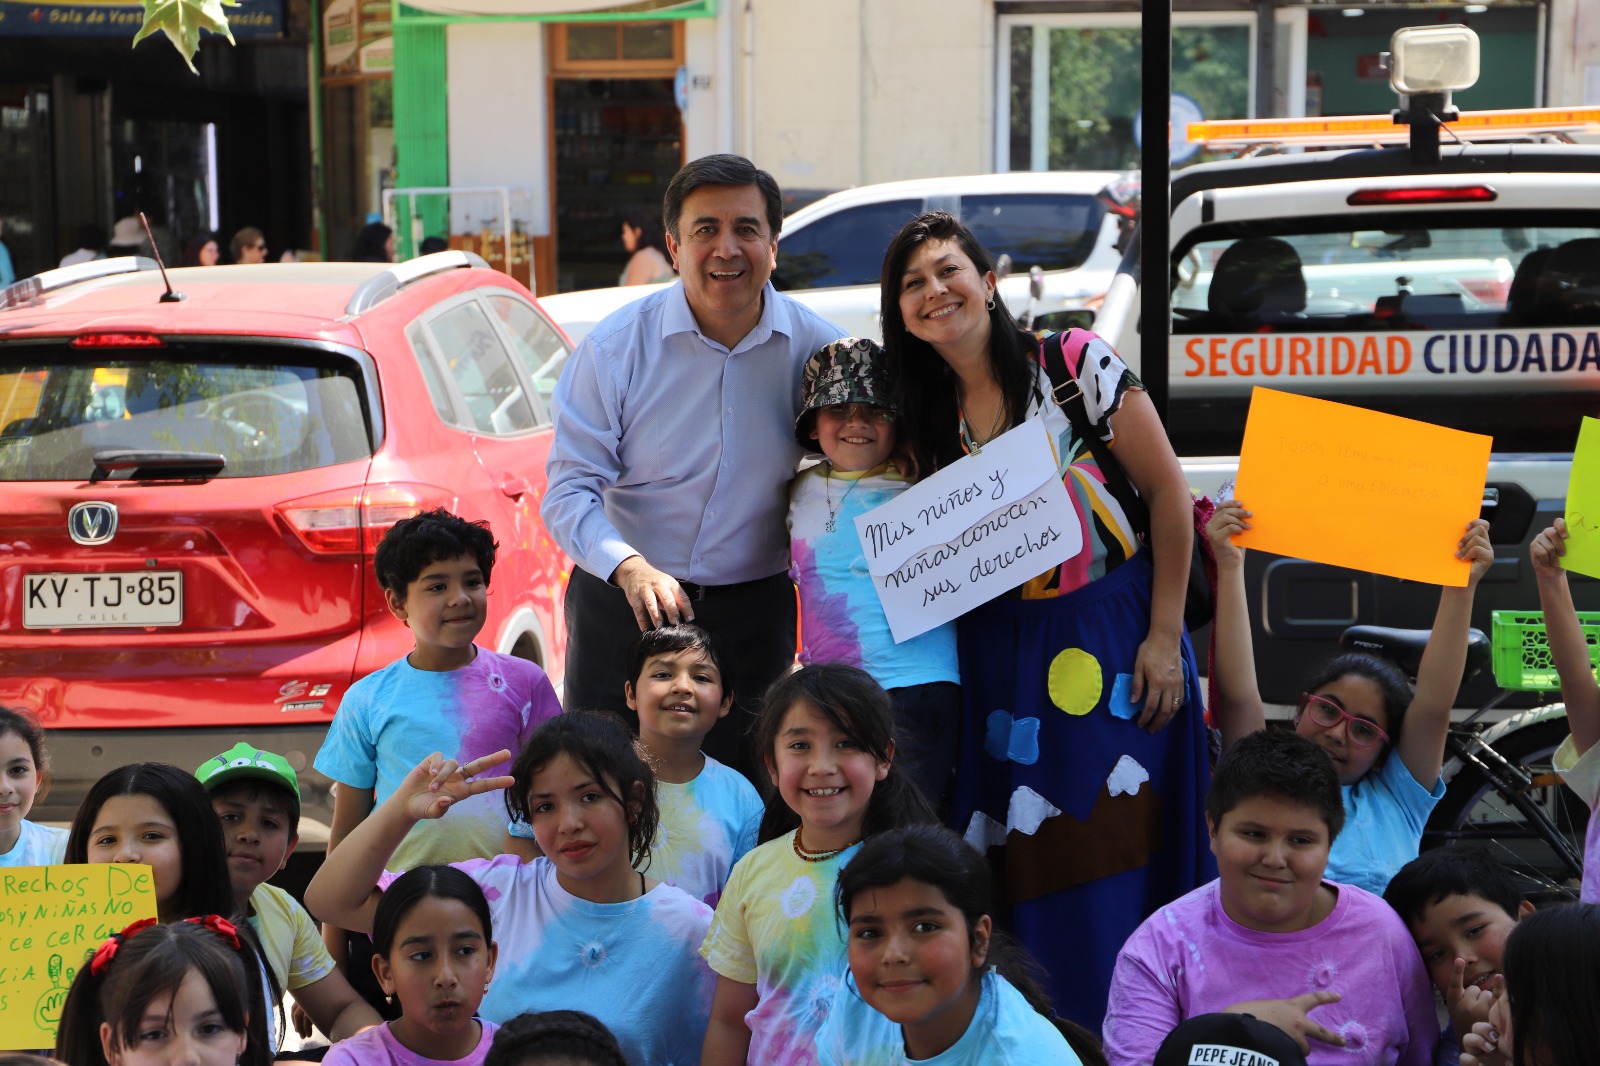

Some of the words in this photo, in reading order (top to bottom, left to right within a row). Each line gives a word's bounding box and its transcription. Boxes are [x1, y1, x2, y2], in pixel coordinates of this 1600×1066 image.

[1184, 336, 1412, 377] SEGURIDAD
[1423, 332, 1600, 374] CIUDADA
[865, 520, 915, 559] Mis
[917, 482, 983, 526] niños
[988, 468, 1009, 501] y
[885, 542, 960, 588] niñas
[961, 495, 1048, 548] conocen
[922, 578, 963, 608] sus
[969, 525, 1061, 584] derechos
[77, 612, 129, 622] CHILE
[104, 898, 133, 915] NO
[1194, 1047, 1229, 1064] PEPE
